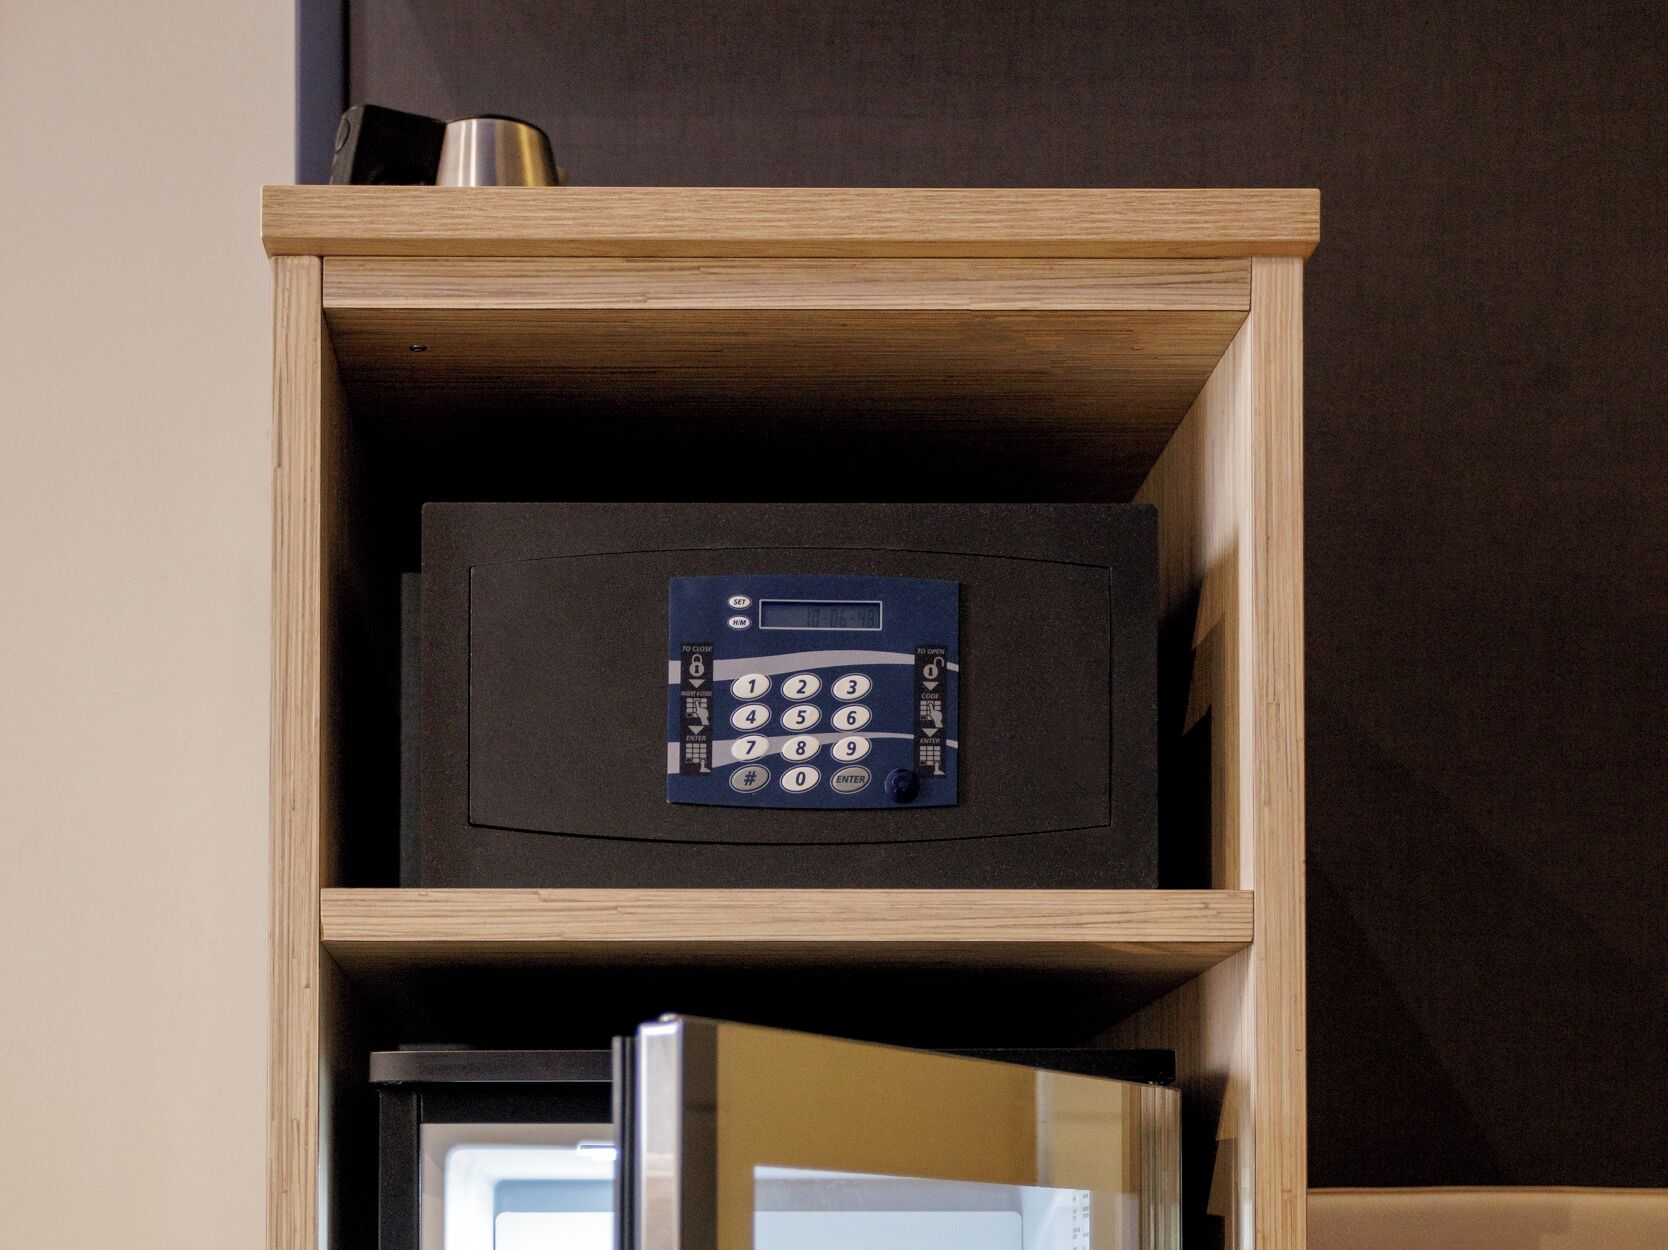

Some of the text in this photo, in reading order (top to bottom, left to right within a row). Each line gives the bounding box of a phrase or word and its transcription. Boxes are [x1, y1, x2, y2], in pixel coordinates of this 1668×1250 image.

[733, 598, 747, 606] SET
[748, 679, 857, 695] 1 2 3
[746, 710, 857, 725] 4 5 6
[746, 741, 856, 756] 7 8 9
[743, 771, 866, 786] # 0 ENTER
